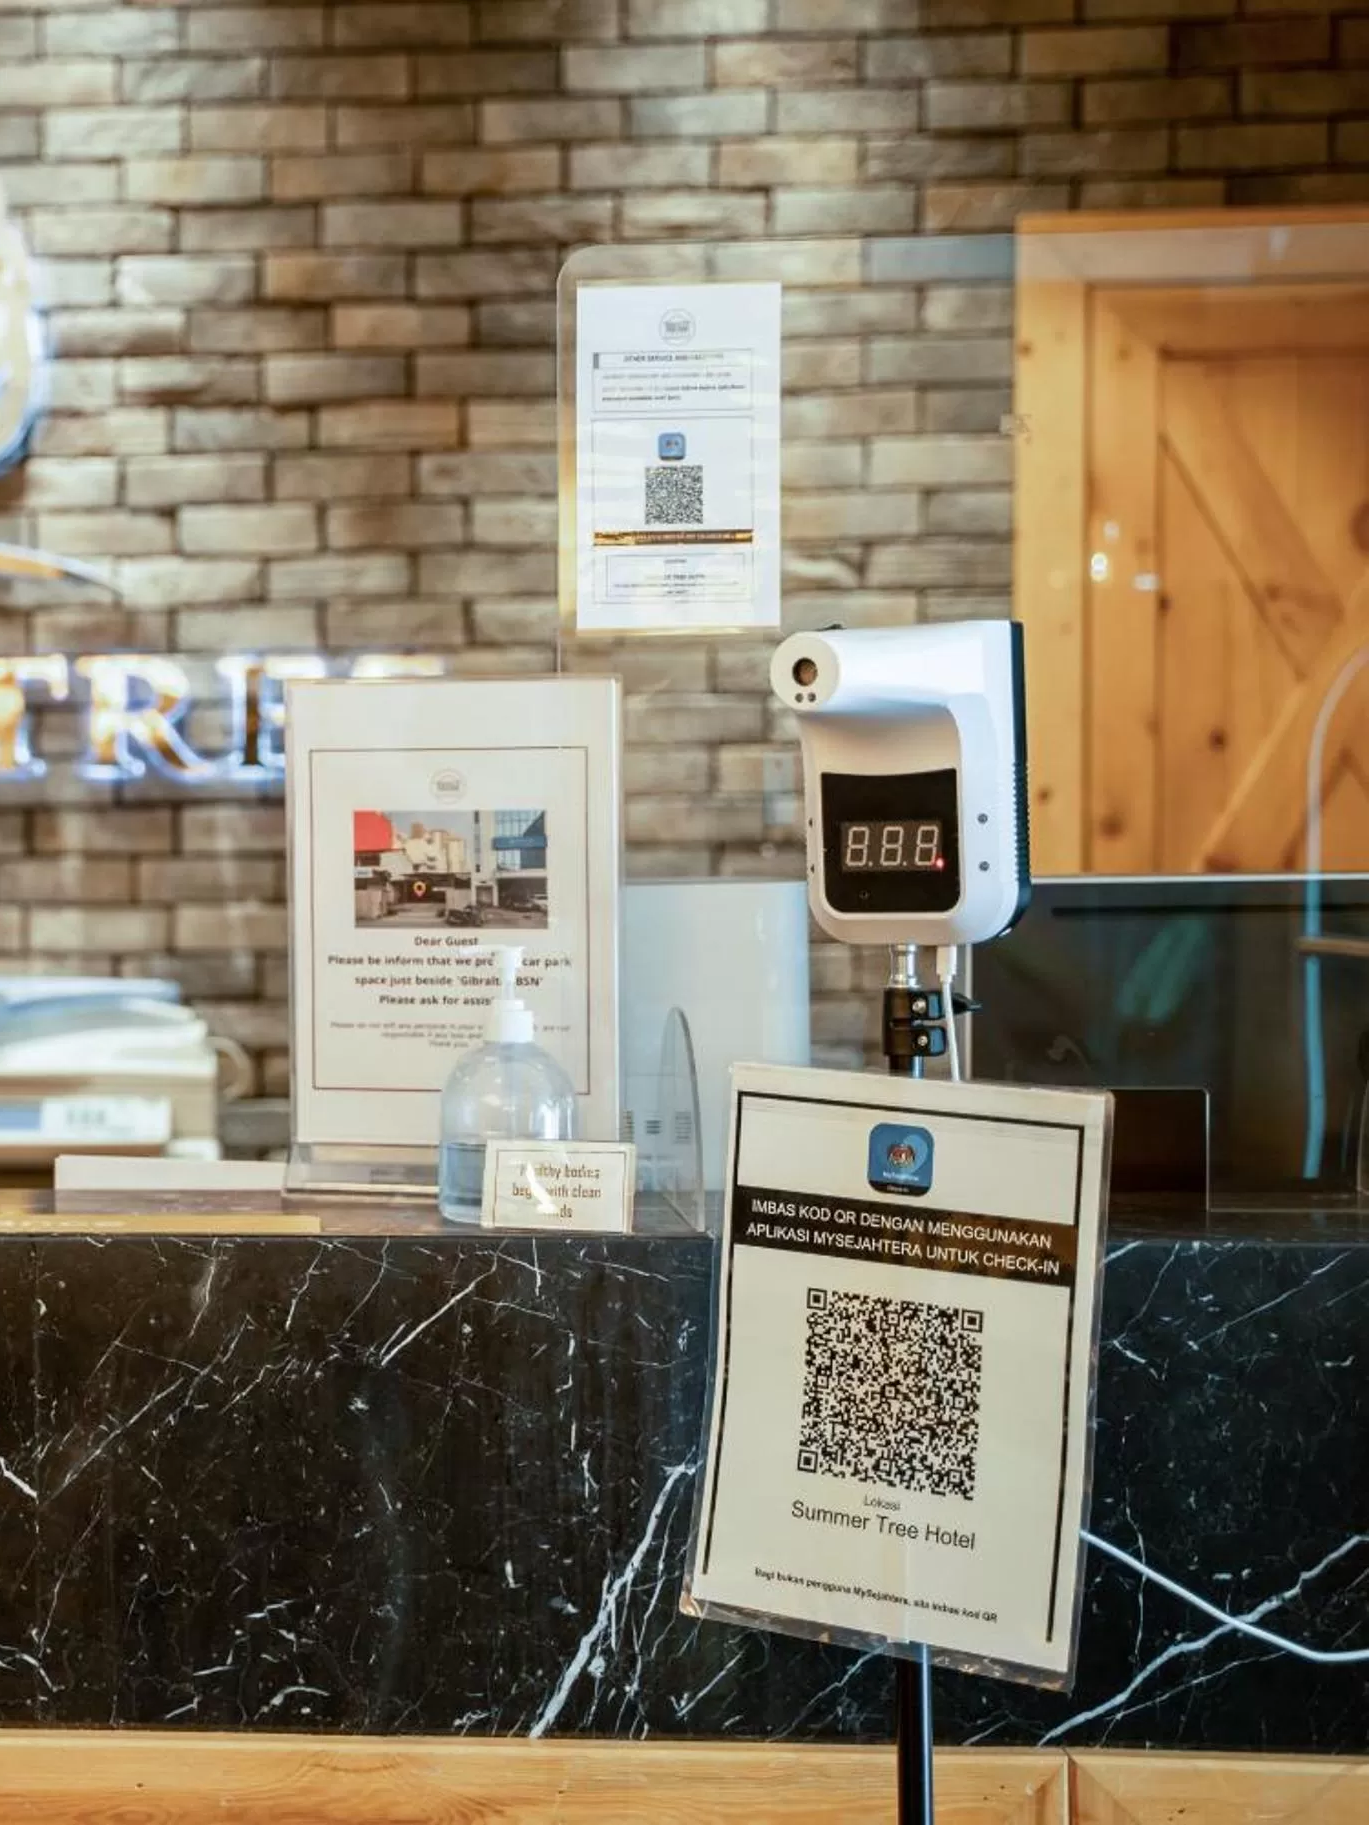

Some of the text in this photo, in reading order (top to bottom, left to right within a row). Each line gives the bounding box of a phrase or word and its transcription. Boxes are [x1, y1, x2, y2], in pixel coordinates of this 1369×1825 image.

[413, 935, 479, 947] Dear Guest
[327, 954, 364, 966] Please
[367, 955, 381, 966] be
[384, 955, 425, 966] inform
[427, 955, 452, 967] that
[454, 957, 472, 967] we
[522, 957, 540, 967] car
[354, 976, 387, 988] space
[389, 975, 412, 988] just
[415, 974, 453, 986] beside
[378, 994, 415, 1006] Please
[418, 995, 440, 1005] ask
[442, 995, 460, 1005] for
[572, 1184, 601, 1198] clean
[751, 1199, 1053, 1249] IMBAS KOD QR DENGAN MENGGUNAKAN
[746, 1222, 1060, 1276] APLIKASI MYSEJAHTERA UNTUK CHECK-IN
[863, 1494, 901, 1511] Lokasi
[791, 1499, 976, 1551] Summer Tree Hotel
[981, 1611, 998, 1624] QR
